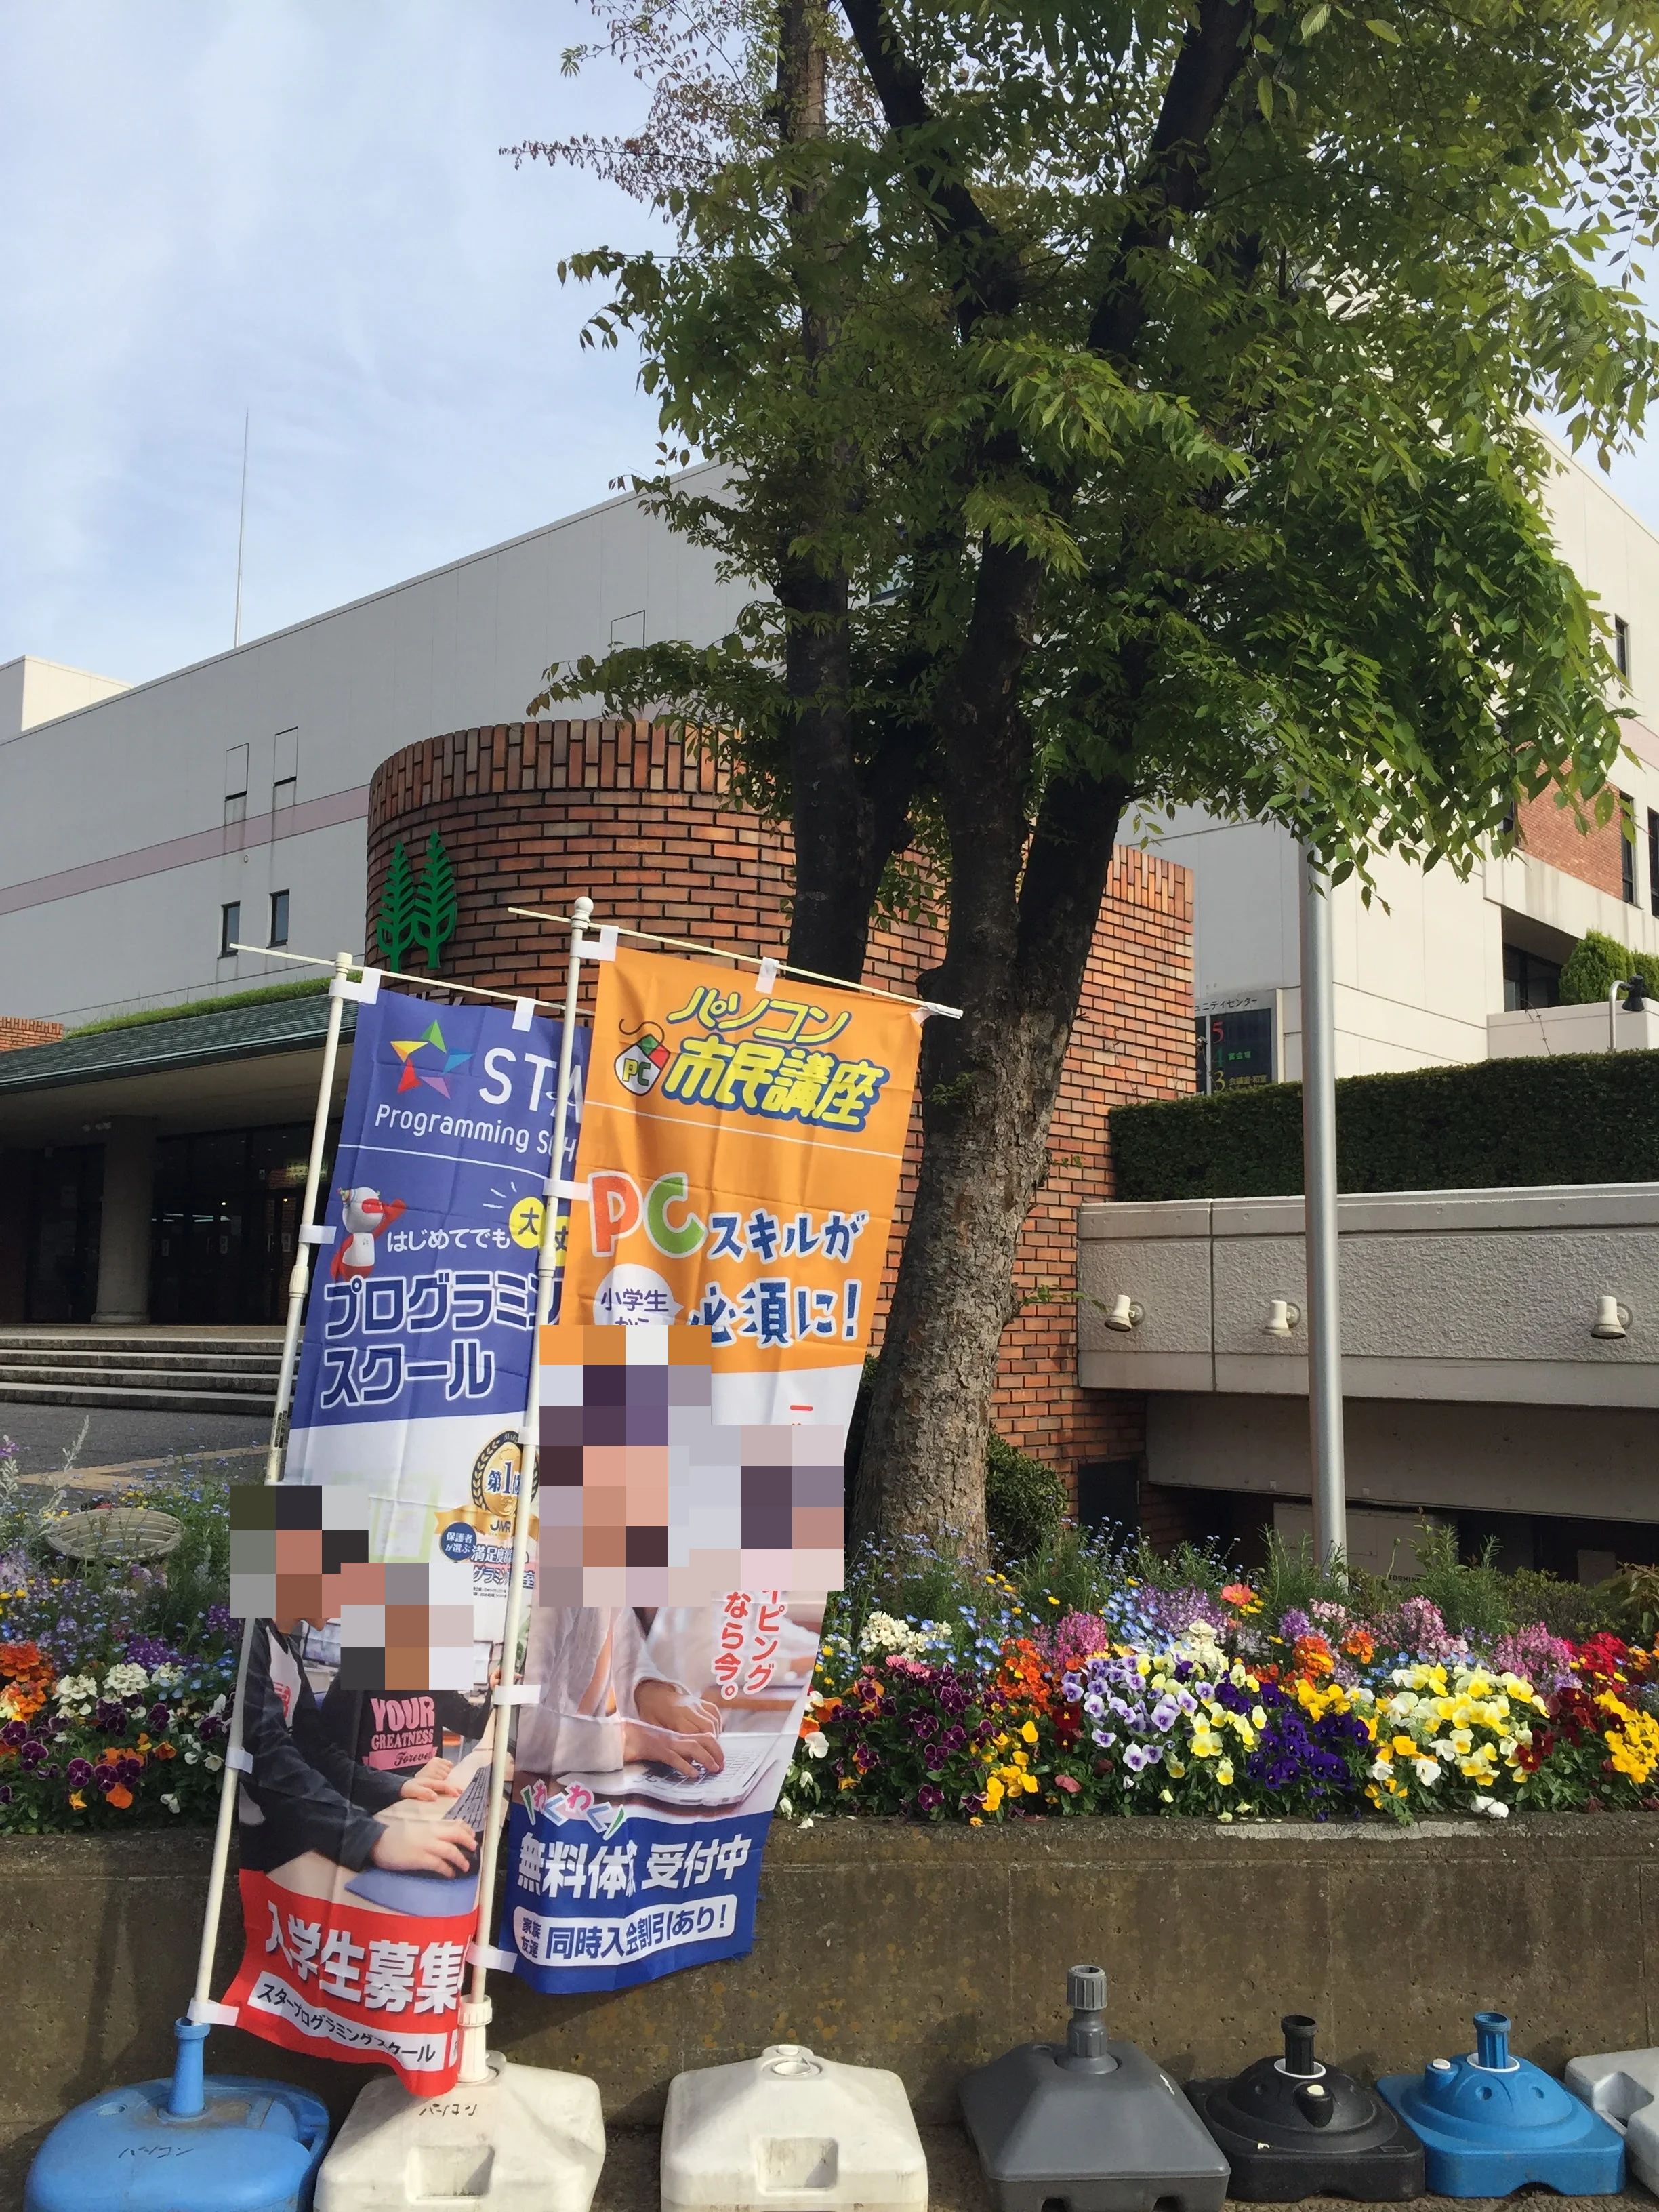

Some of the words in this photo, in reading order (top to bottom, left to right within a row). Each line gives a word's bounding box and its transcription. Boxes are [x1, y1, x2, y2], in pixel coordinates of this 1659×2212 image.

[666, 987, 851, 1044] パソコン
[1212, 1021, 1225, 1044] 5
[622, 1059, 651, 1087] PC
[663, 1035, 886, 1128] 市民講座
[375, 1104, 529, 1153] Programming
[387, 1227, 510, 1254] はじめてでも
[600, 1288, 669, 1311] 小学生
[321, 1340, 495, 1409] スクール
[445, 1542, 470, 1553] が選ぶ
[447, 1532, 473, 1544] 保護者
[371, 1696, 434, 1732] YOUR
[371, 1729, 434, 1750] GREATNESS
[521, 1917, 541, 1940] 家族
[545, 1904, 727, 1960] 同時入会割引あり!
[265, 1900, 464, 2015] 入学生募集
